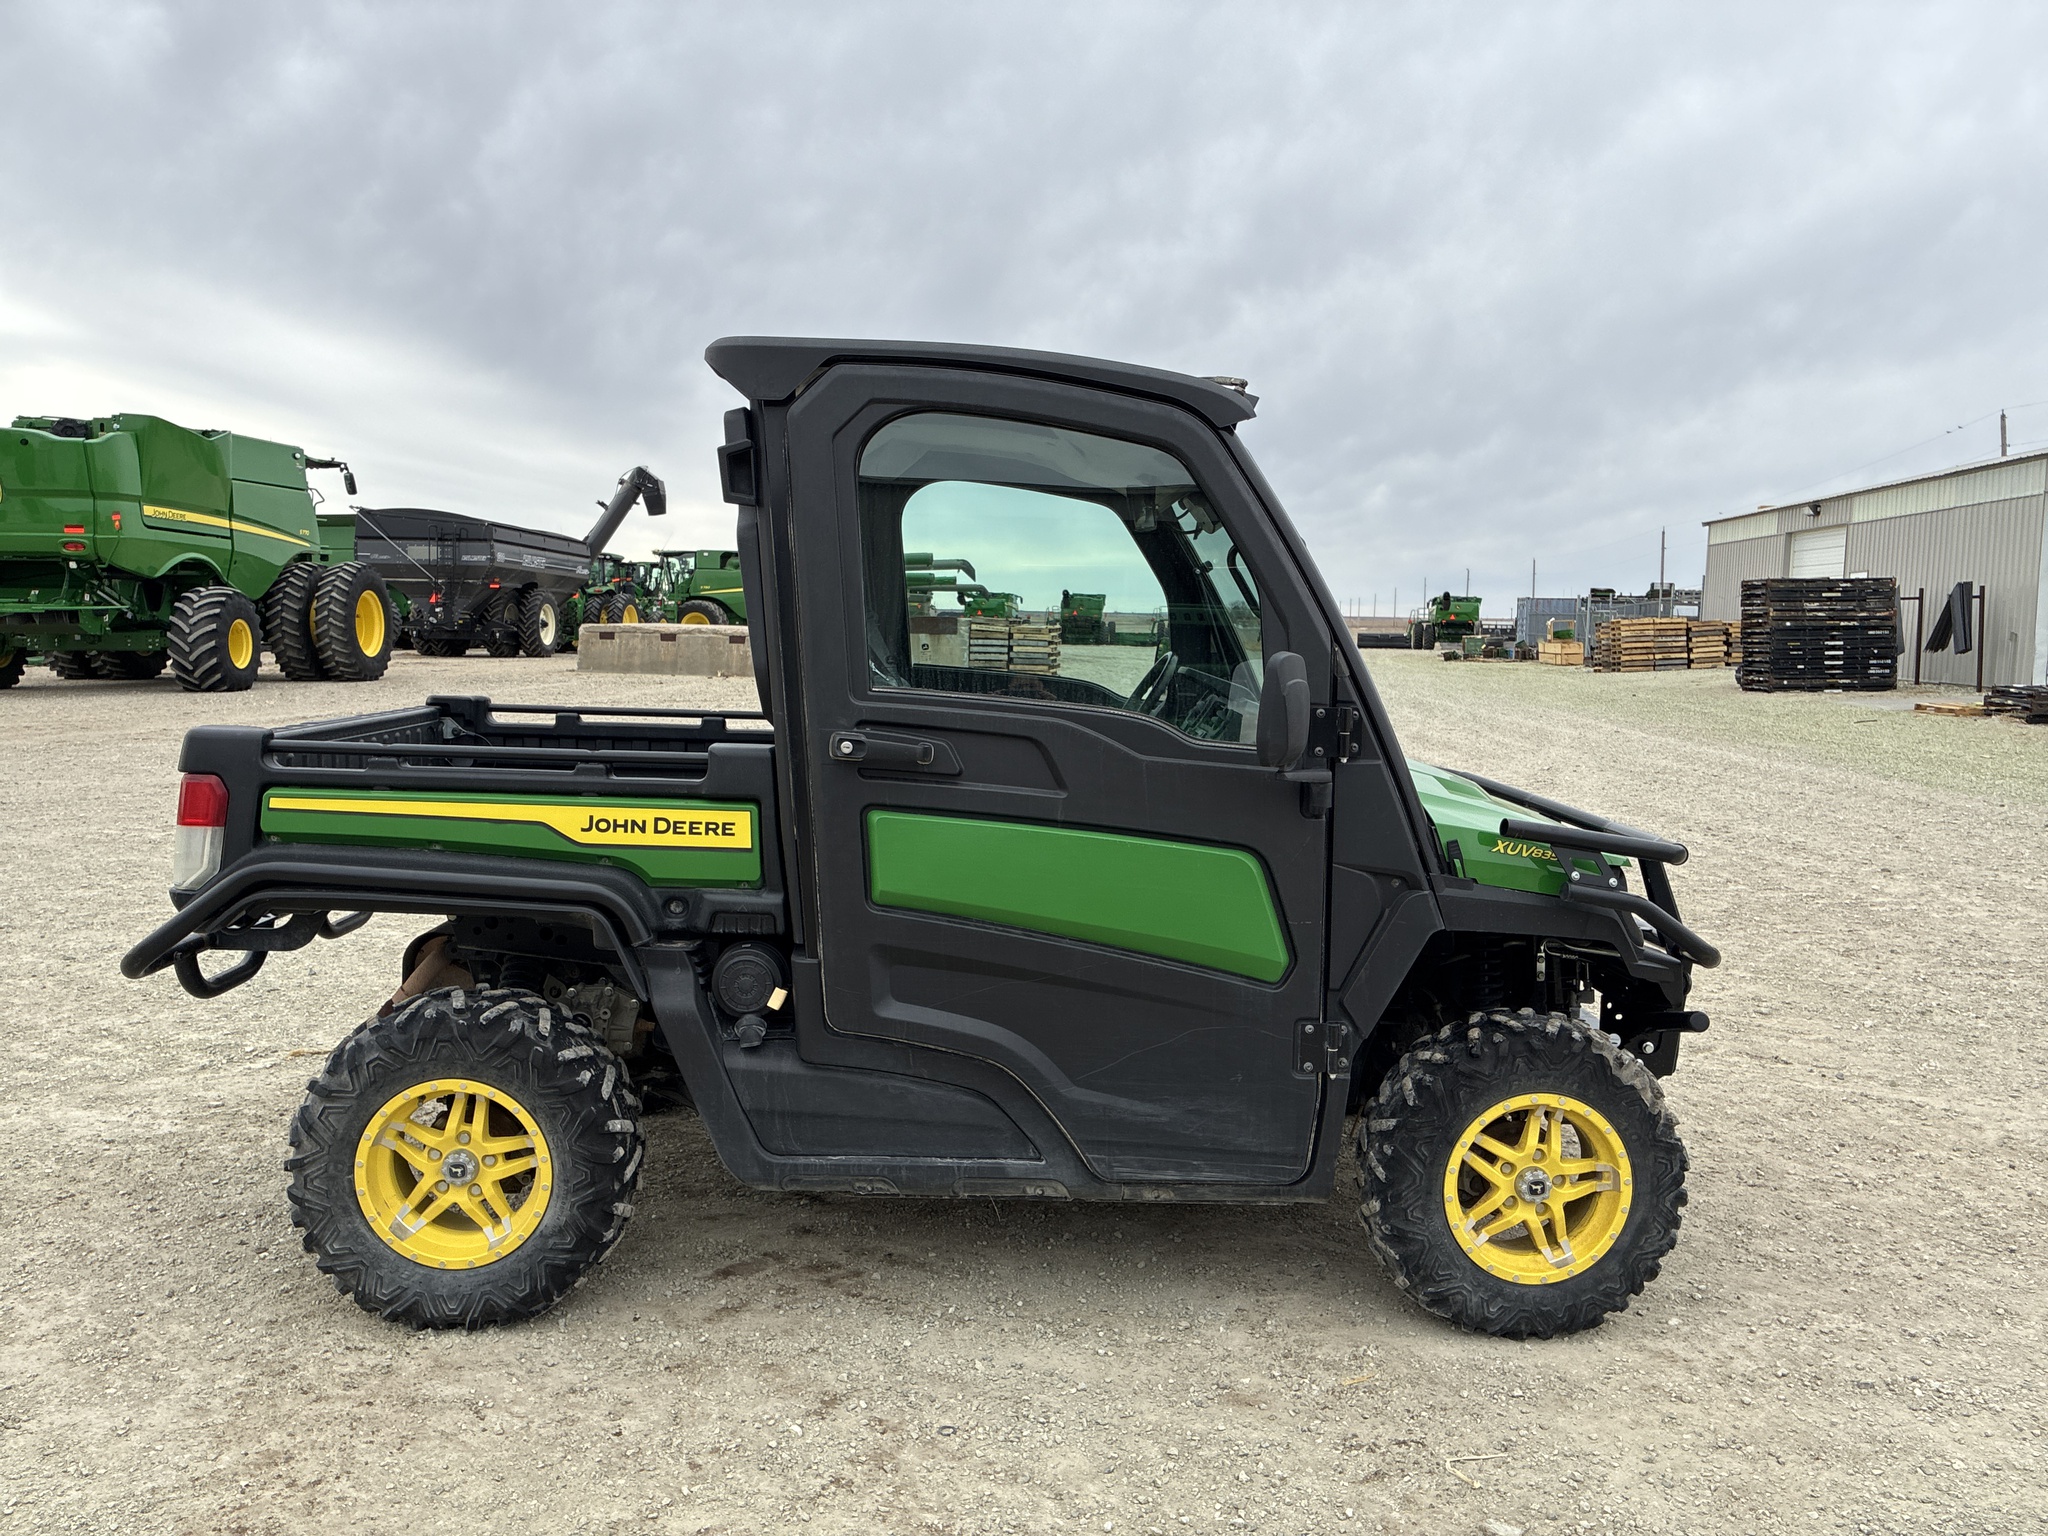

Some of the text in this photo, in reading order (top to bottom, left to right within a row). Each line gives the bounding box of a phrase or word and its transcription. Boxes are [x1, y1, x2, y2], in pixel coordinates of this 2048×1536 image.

[152, 508, 186, 520] JOHN DEERE
[580, 815, 736, 837] JOHN DEERE
